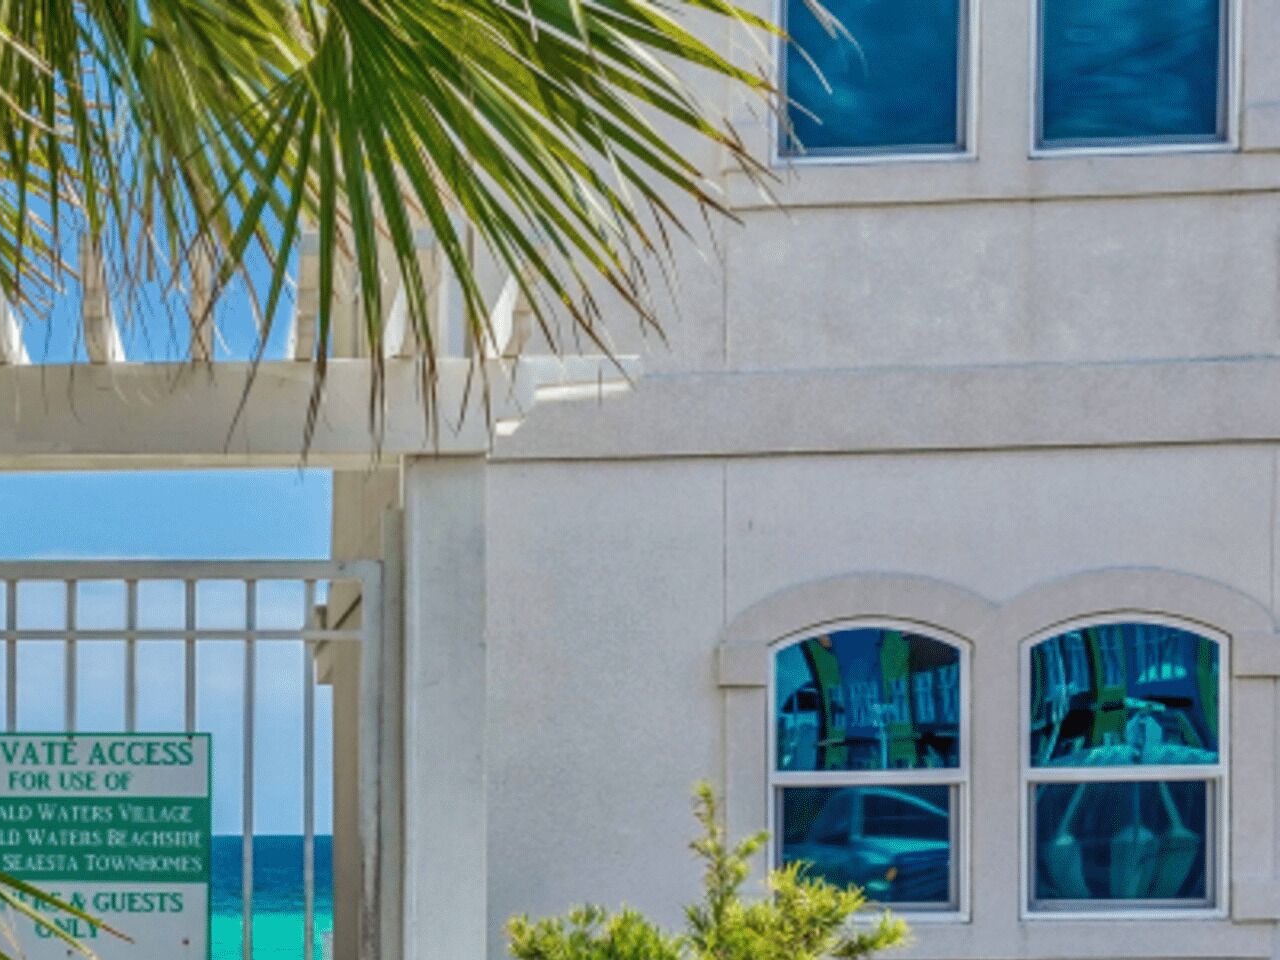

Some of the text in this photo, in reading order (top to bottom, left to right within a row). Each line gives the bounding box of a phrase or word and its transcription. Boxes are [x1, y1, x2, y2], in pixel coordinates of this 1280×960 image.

[88, 741, 193, 766] ACCESS
[8, 770, 132, 791] FOR USE OF
[37, 802, 113, 822] WATERS
[118, 802, 193, 823] VILLAGE
[92, 891, 184, 913] GUESTS
